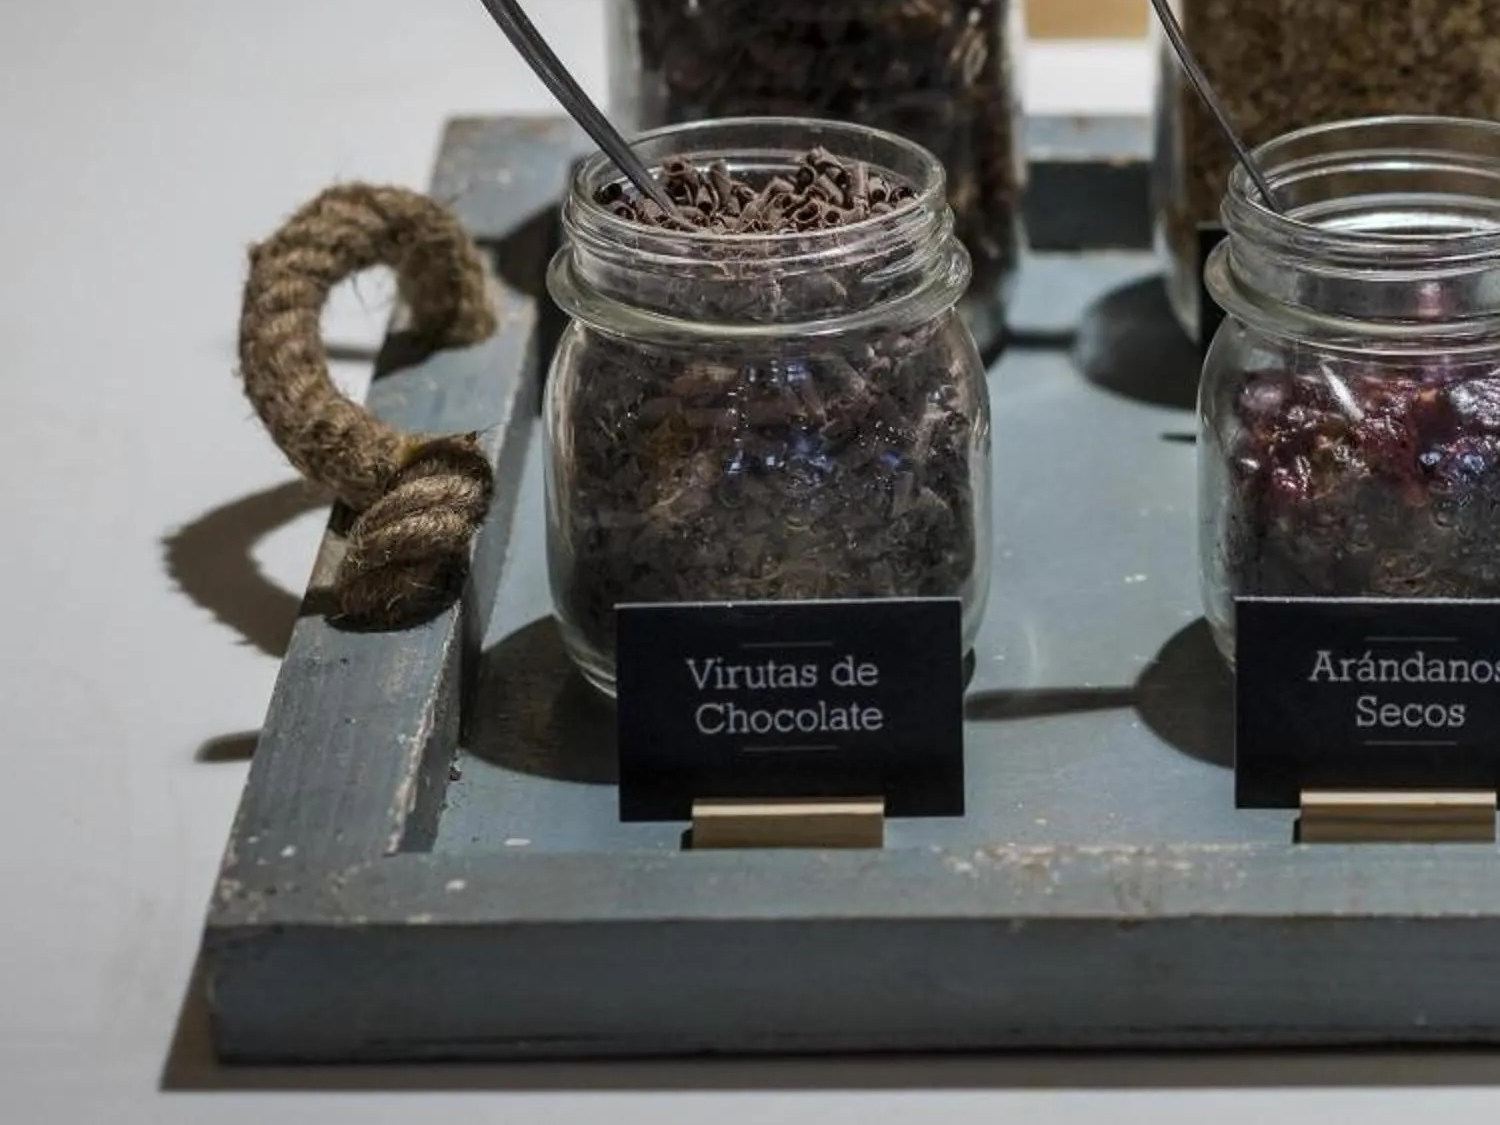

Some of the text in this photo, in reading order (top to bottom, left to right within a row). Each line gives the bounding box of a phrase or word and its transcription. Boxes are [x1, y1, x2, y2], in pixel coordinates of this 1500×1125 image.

[685, 654, 880, 690] Virutas de
[695, 699, 884, 735] Chocolate
[1355, 694, 1467, 728] Secos
